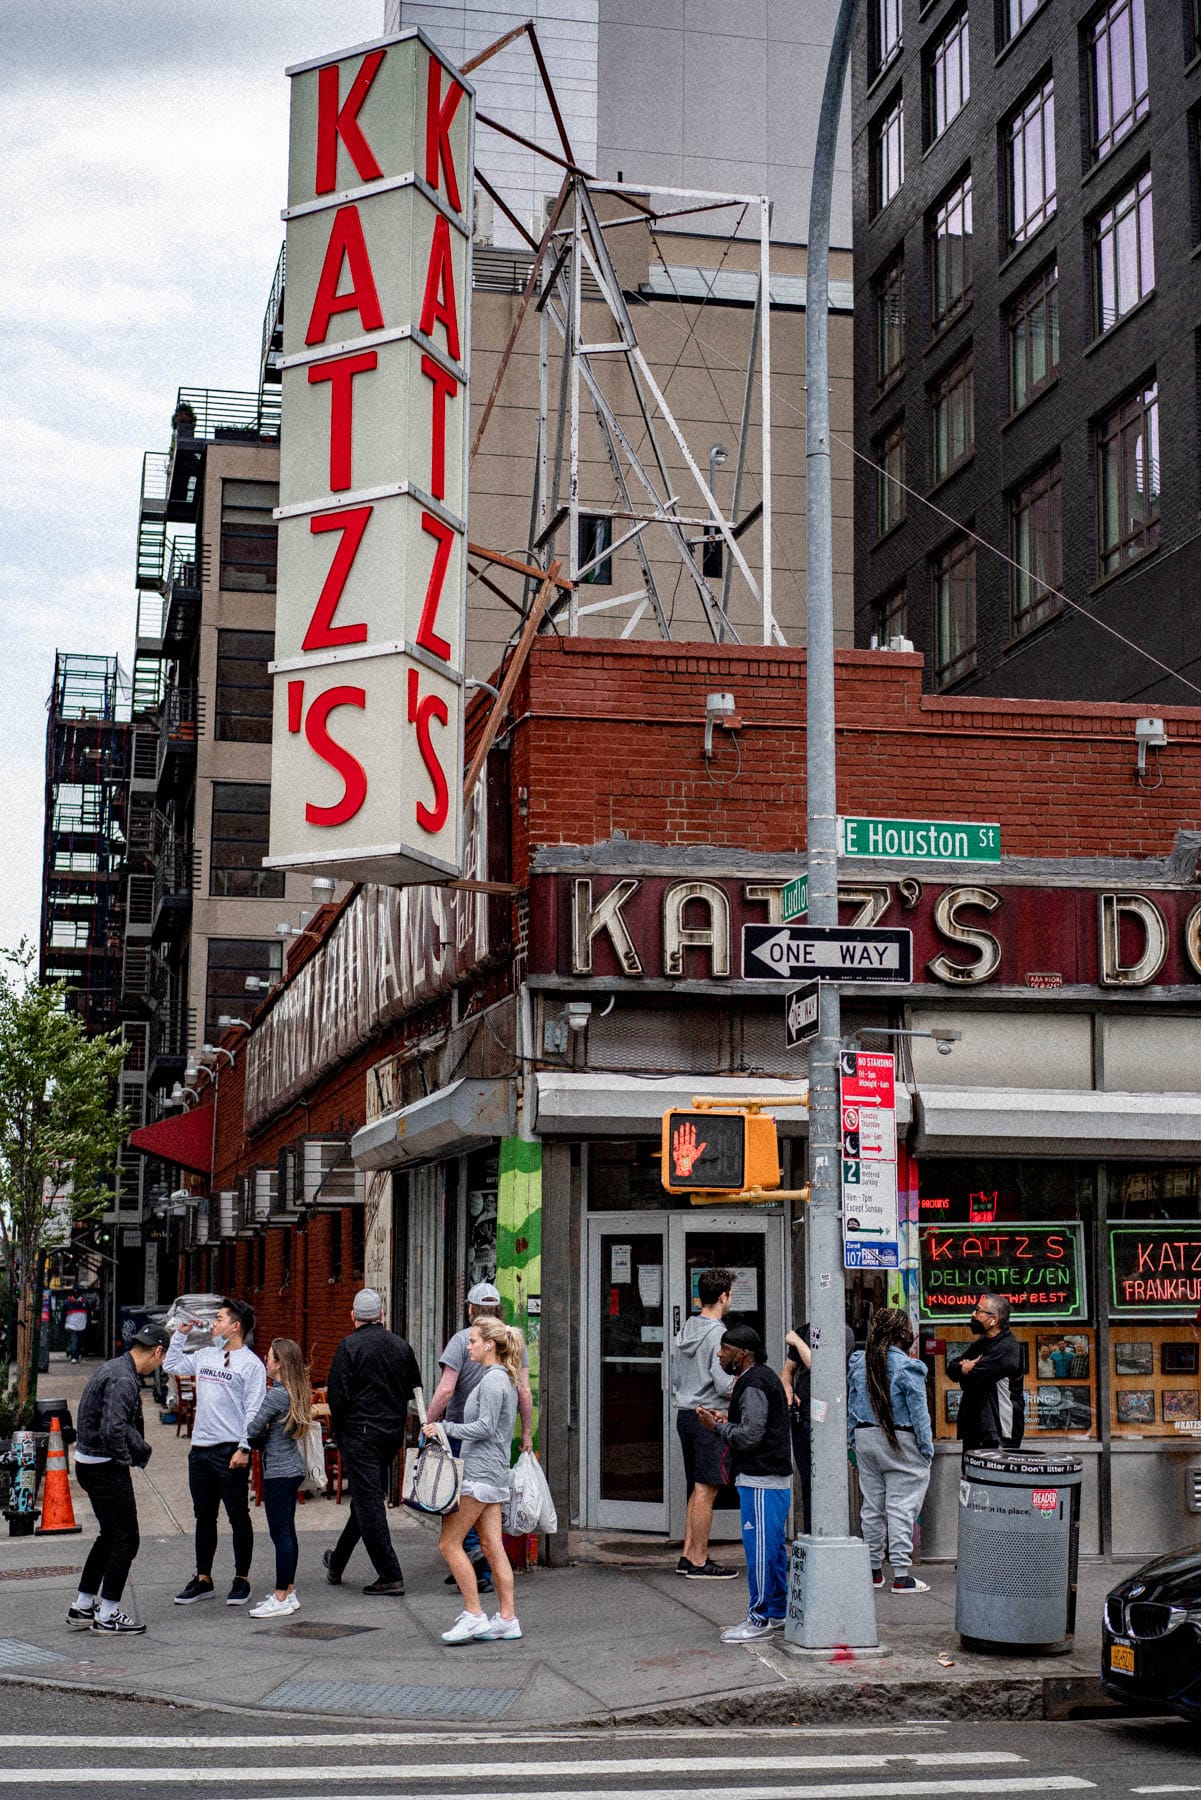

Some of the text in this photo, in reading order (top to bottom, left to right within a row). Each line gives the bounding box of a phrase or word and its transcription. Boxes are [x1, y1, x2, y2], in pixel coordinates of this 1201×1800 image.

[287, 49, 387, 827] KATZ'S
[407, 55, 464, 833] KATZ'S
[846, 822, 995, 857] E Houston St
[784, 879, 809, 917] Ludlo
[769, 942, 889, 966] ONE WAY
[791, 998, 815, 1028] ONE WAY
[857, 1057, 893, 1068] NO STANDING
[861, 1111, 878, 1120] Tuesday
[861, 1120, 881, 1129] Thursday
[847, 1161, 857, 1182] 2
[846, 1203, 884, 1214] Except Sunday
[846, 1250, 862, 1265] 107
[929, 1267, 1071, 1288] DELICATESSEN
[927, 1294, 977, 1306] KNOWN
[1029, 1293, 1067, 1303] BEST
[199, 1367, 233, 1381] KIRKLAND
[969, 1457, 986, 1468] Don't
[986, 1461, 1006, 1470] litter
[1021, 1464, 1045, 1473] Don't
[1047, 1465, 1065, 1473] litter
